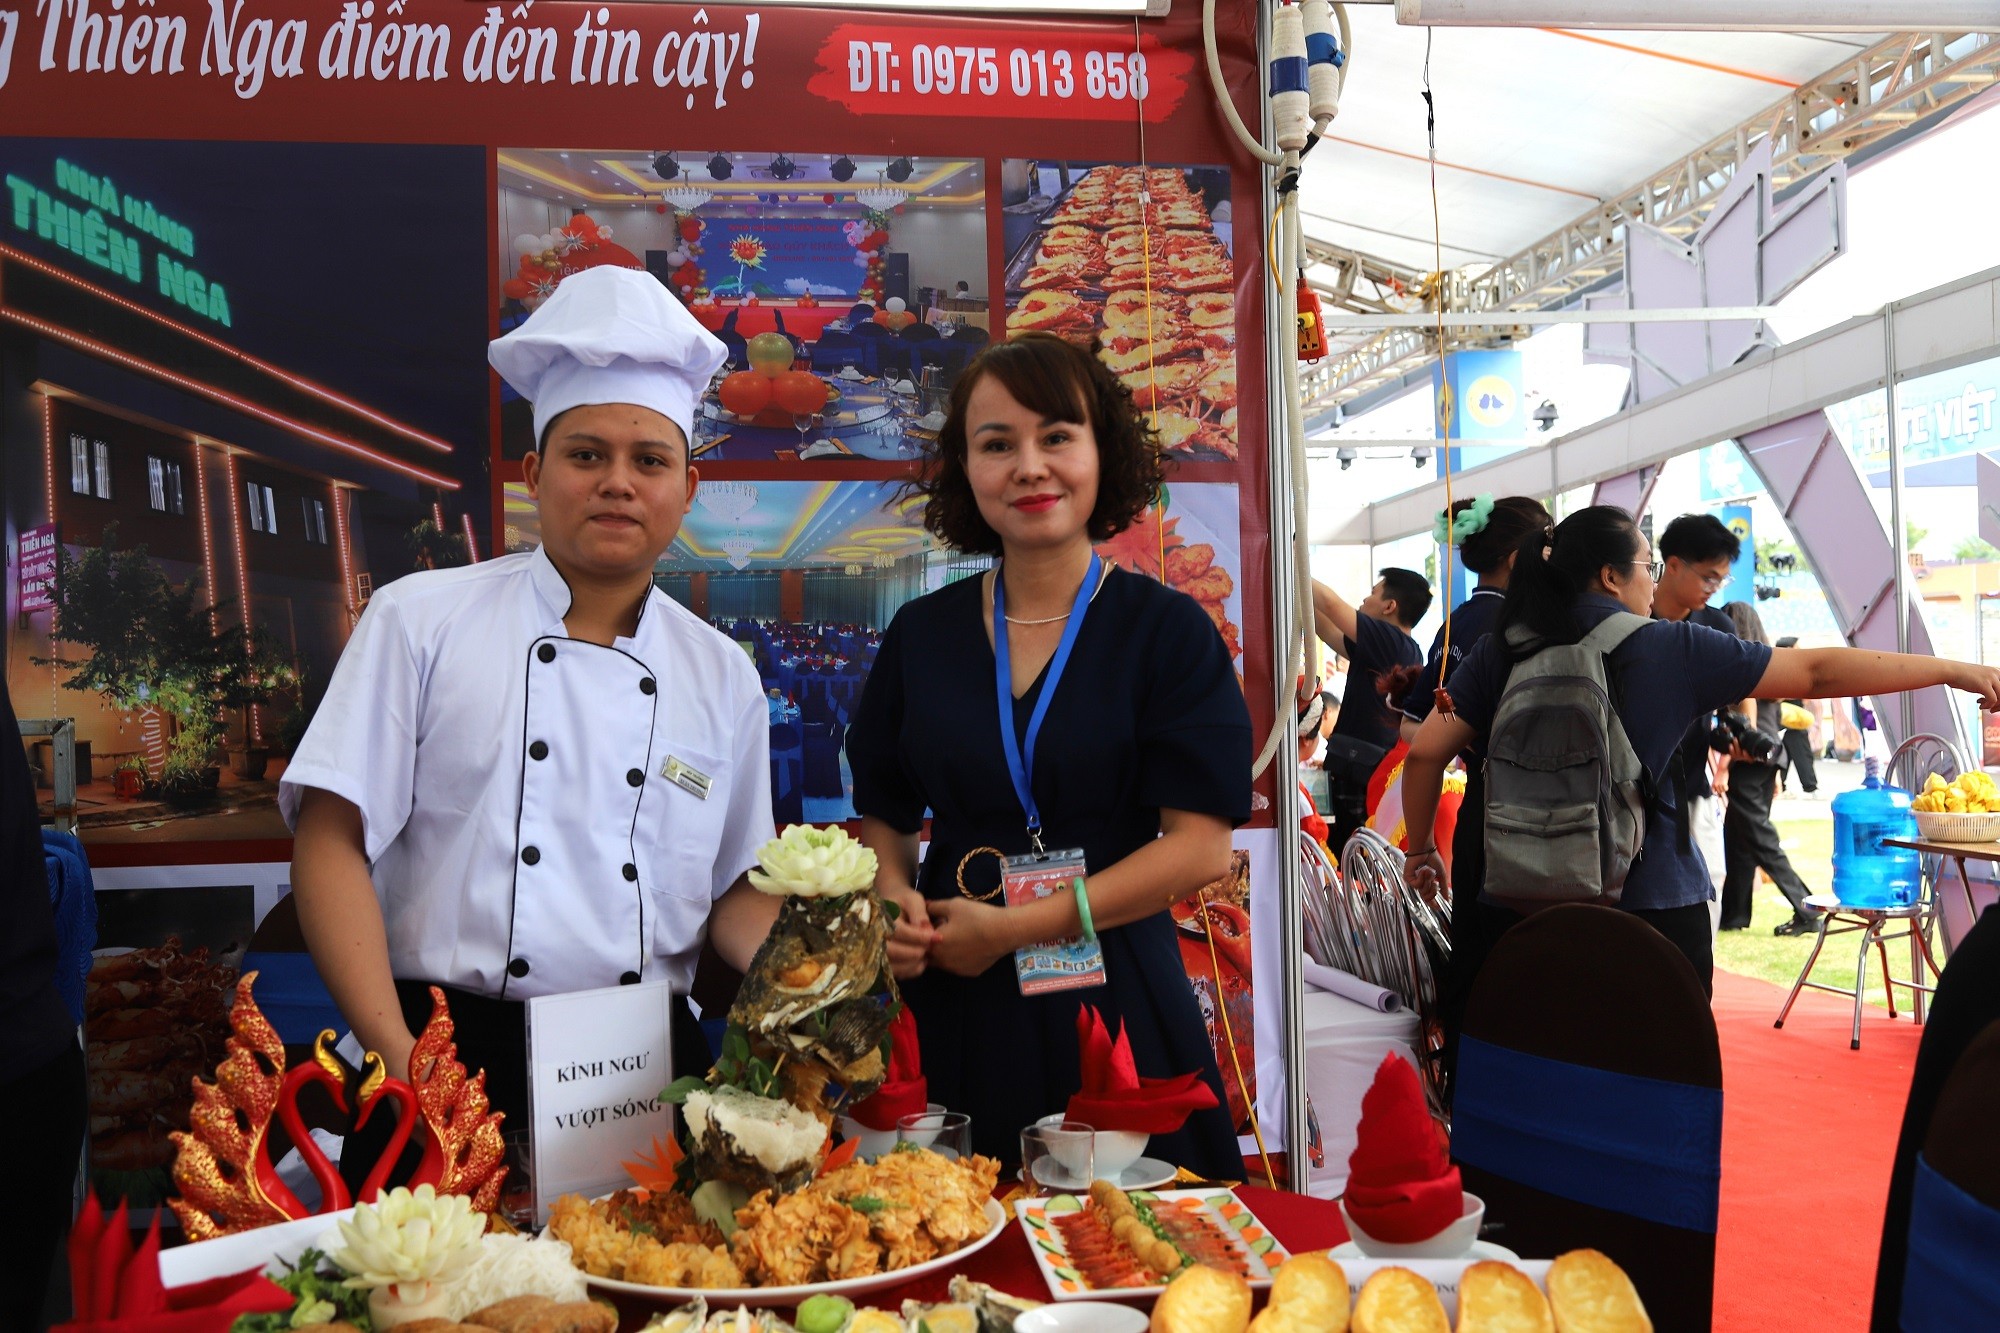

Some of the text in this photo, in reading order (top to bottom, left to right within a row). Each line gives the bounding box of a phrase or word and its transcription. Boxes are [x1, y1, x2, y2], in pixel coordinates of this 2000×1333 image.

[36, 0, 187, 75] Thiên
[199, 0, 308, 99] Nga
[318, 0, 451, 80] điểm
[462, 0, 557, 84] đến
[570, 7, 641, 86] tin
[652, 8, 760, 110] cậy!
[848, 40, 1149, 100] ĐT: 0975 013 858
[55, 157, 194, 258] NHÀ HÀNG
[5, 173, 231, 328] THIÊN NGA
[1934, 381, 1997, 443] VIỆT
[557, 1051, 650, 1083] KÌNH NGƯ
[555, 1098, 662, 1130] VƯỢT SÓNG
